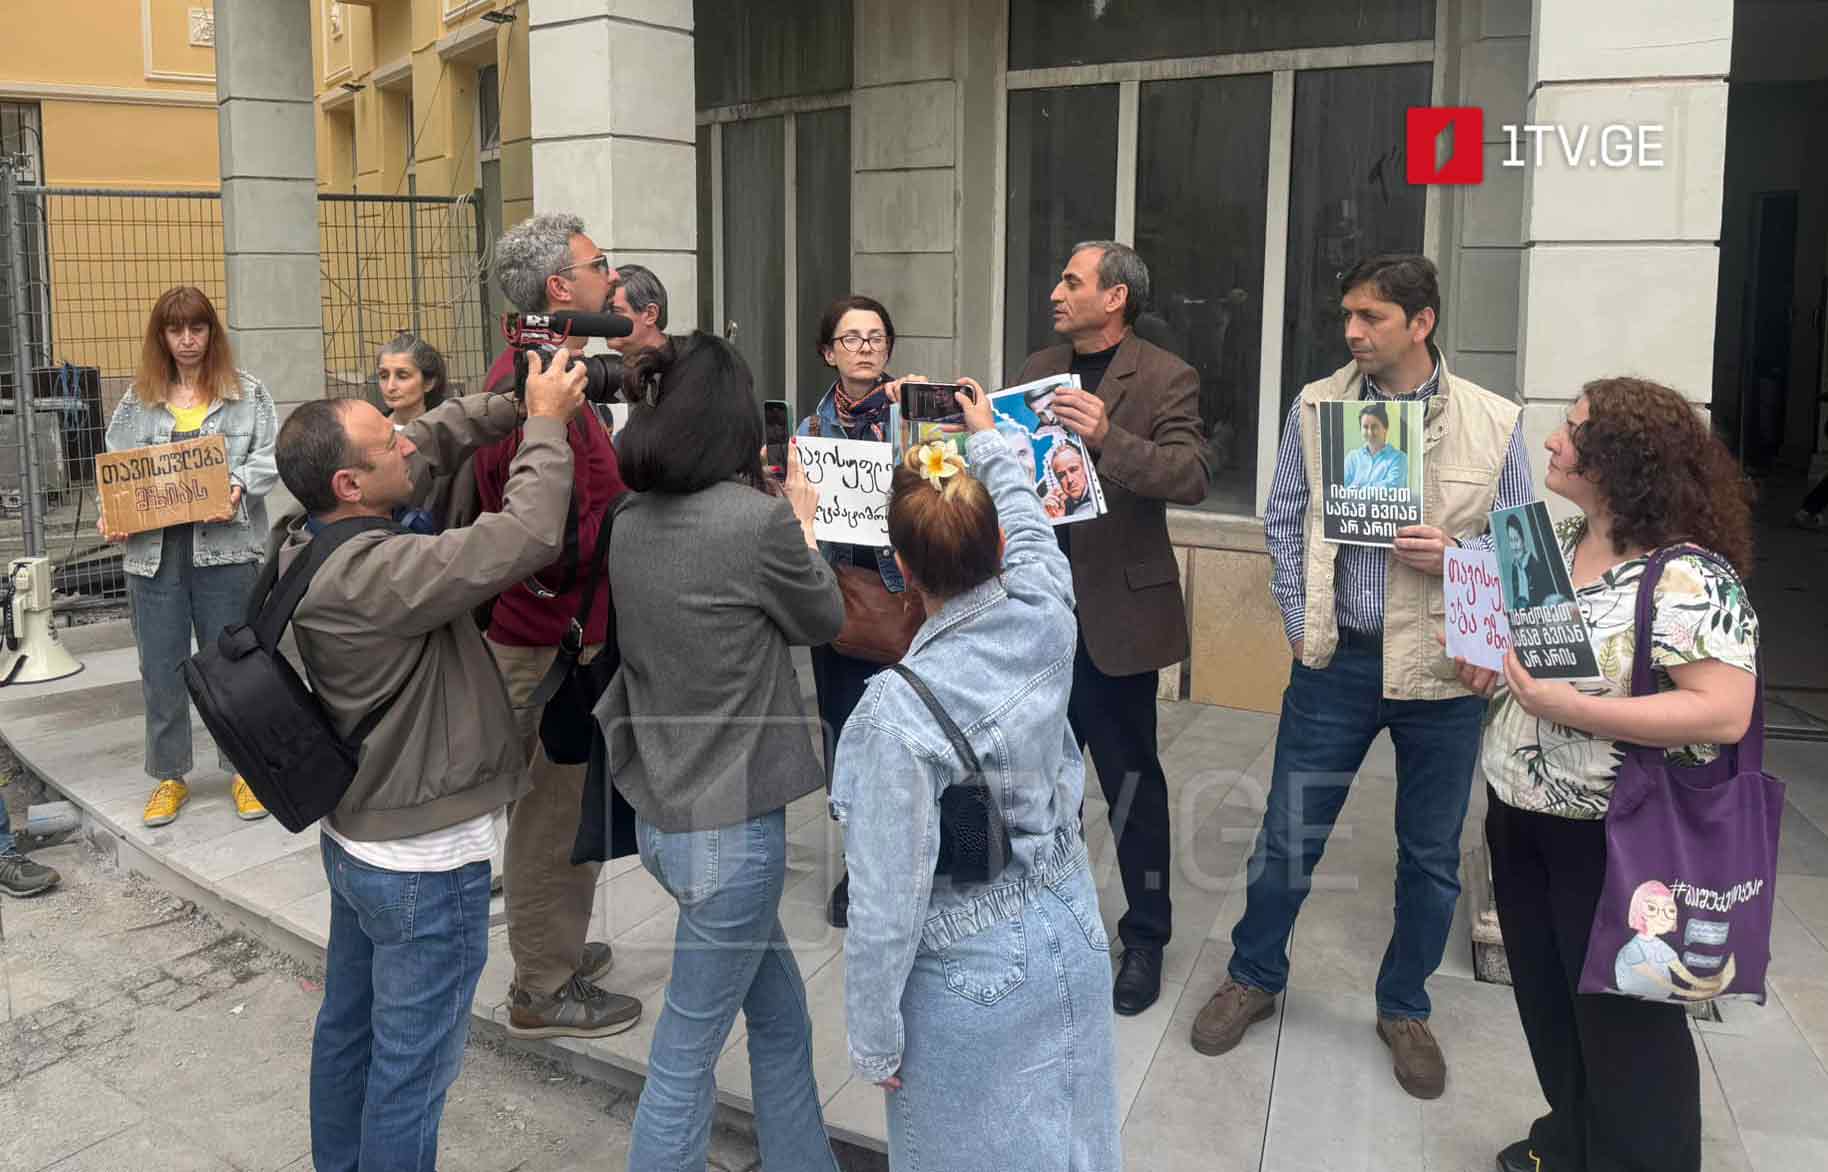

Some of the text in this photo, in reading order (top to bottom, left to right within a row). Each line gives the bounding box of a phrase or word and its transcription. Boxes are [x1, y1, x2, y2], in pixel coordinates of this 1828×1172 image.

[796, 445, 893, 495] ავისუფლ
[1330, 484, 1411, 503] იბრძოლეთ
[1326, 501, 1418, 520] სანამ გვიან
[1340, 519, 1358, 534] არ
[1449, 558, 1507, 617] თავისუ
[1483, 614, 1512, 649] მზი
[1543, 624, 1585, 646] გვიან
[1523, 647, 1577, 668] არ არის
